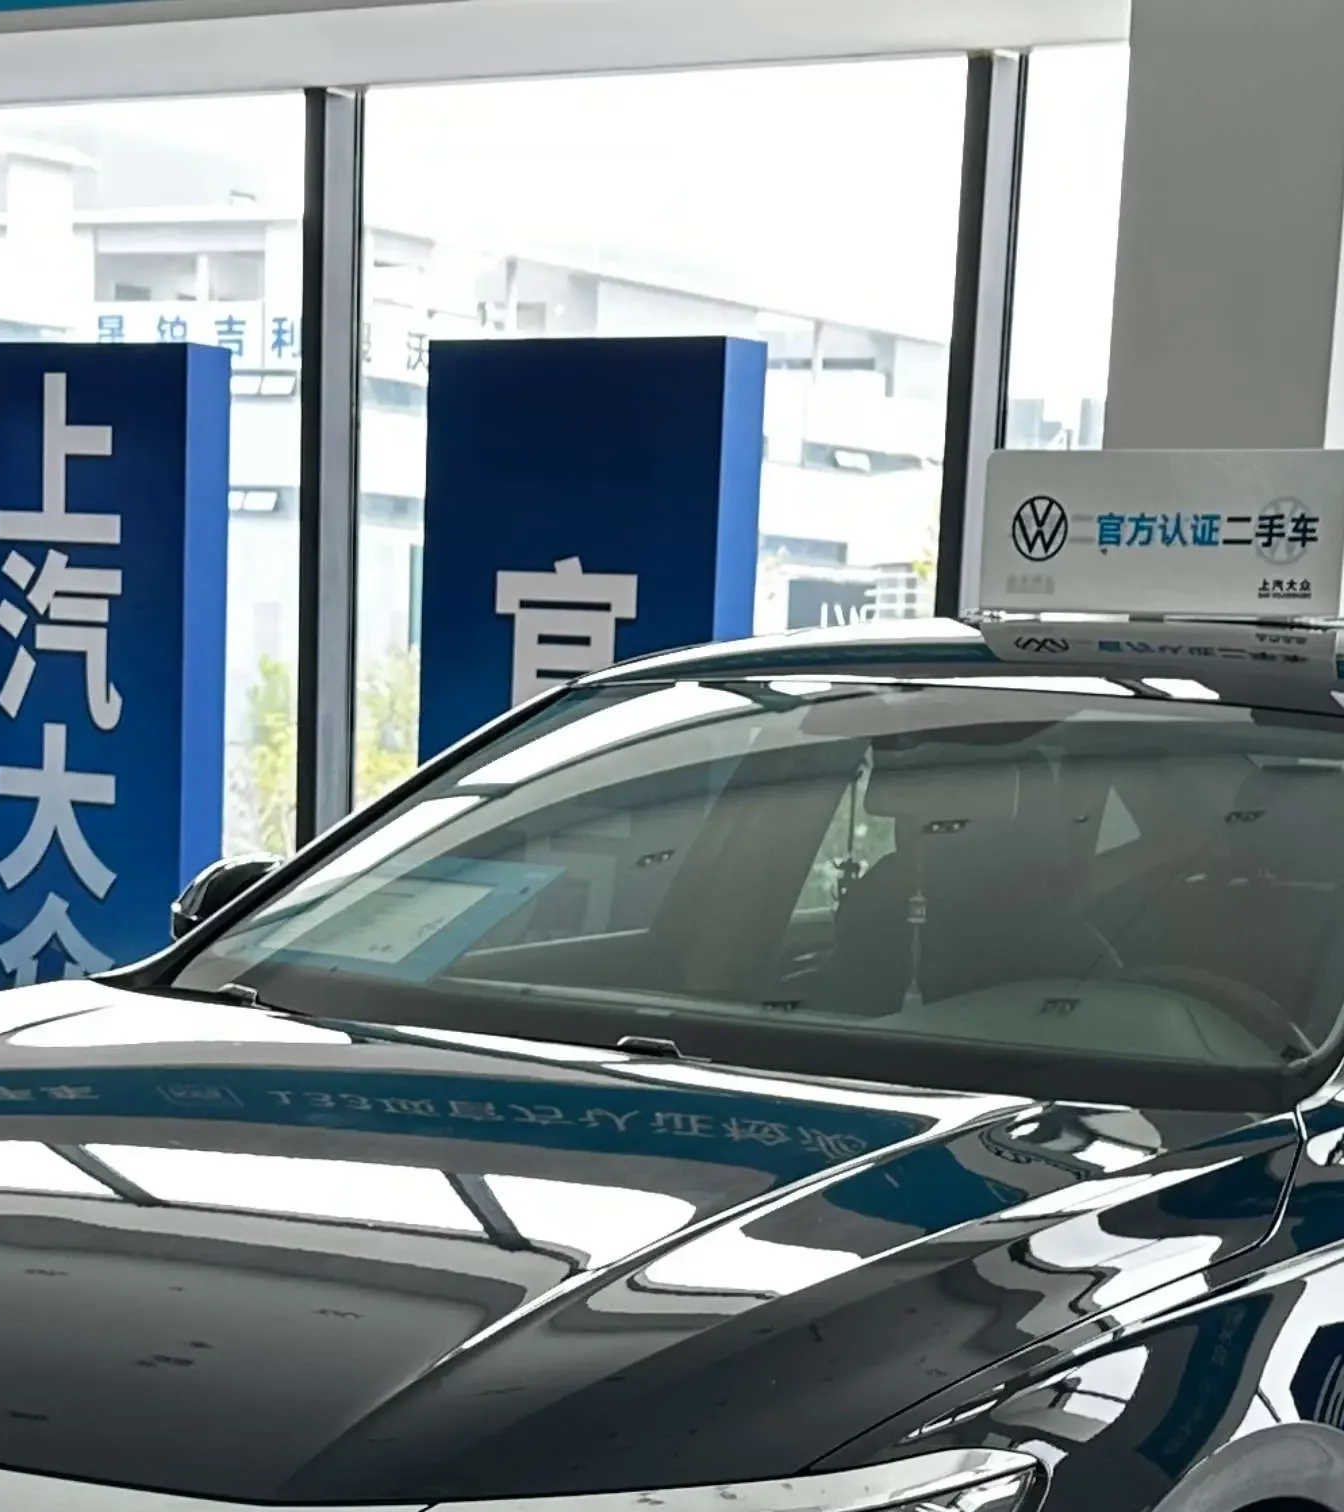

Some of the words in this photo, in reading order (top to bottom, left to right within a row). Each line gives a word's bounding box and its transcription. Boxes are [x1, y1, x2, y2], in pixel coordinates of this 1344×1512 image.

[1096, 511, 1320, 549] 官方认证二手车
[496, 556, 639, 708] 官
